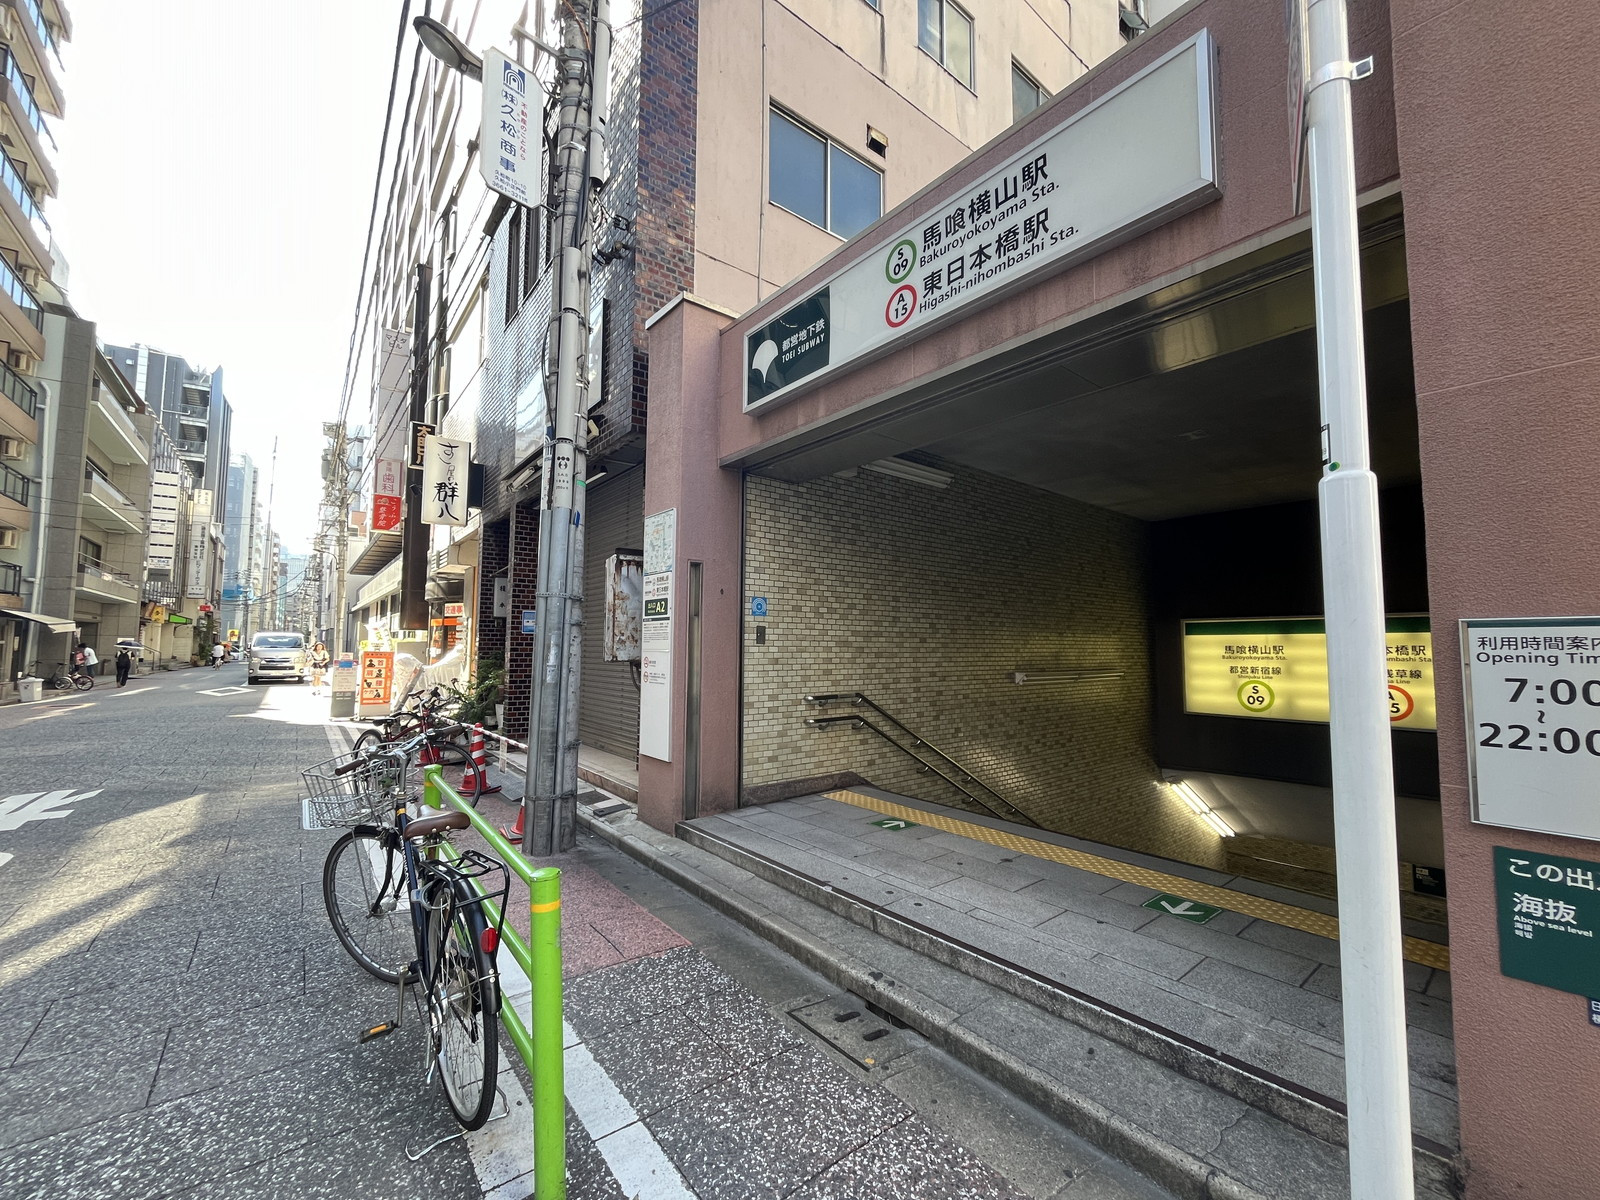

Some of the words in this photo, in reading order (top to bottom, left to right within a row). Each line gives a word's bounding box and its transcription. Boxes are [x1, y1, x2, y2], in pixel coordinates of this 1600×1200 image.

[922, 152, 1049, 253] 馬喰横山駅
[919, 198, 1027, 268] Bakuroyokoyama
[1031, 182, 1060, 202] Sta.
[897, 247, 905, 261] S
[922, 207, 1050, 299] 東日本橋駅
[893, 258, 909, 276] 09
[919, 238, 1045, 314] Higashi-nihombashi
[1049, 224, 1079, 247] Sta.
[897, 293, 905, 306] A
[894, 303, 908, 320] 15
[782, 317, 825, 353] 都営地下鉄
[782, 349, 796, 363] TOEI
[797, 333, 825, 355] SUBWAY
[656, 601, 665, 613] A2
[1224, 645, 1285, 655] 馬喰横山駅
[1476, 652, 1559, 667] Opening
[1229, 666, 1282, 675] 都営新宿線
[1252, 685, 1259, 695] S
[1247, 695, 1265, 705] 09
[1509, 858, 1600, 891] この出
[1512, 892, 1578, 925] 海抜
[1513, 915, 1546, 927] Above
[1547, 923, 1565, 931] sea
[1567, 925, 1593, 938] level
